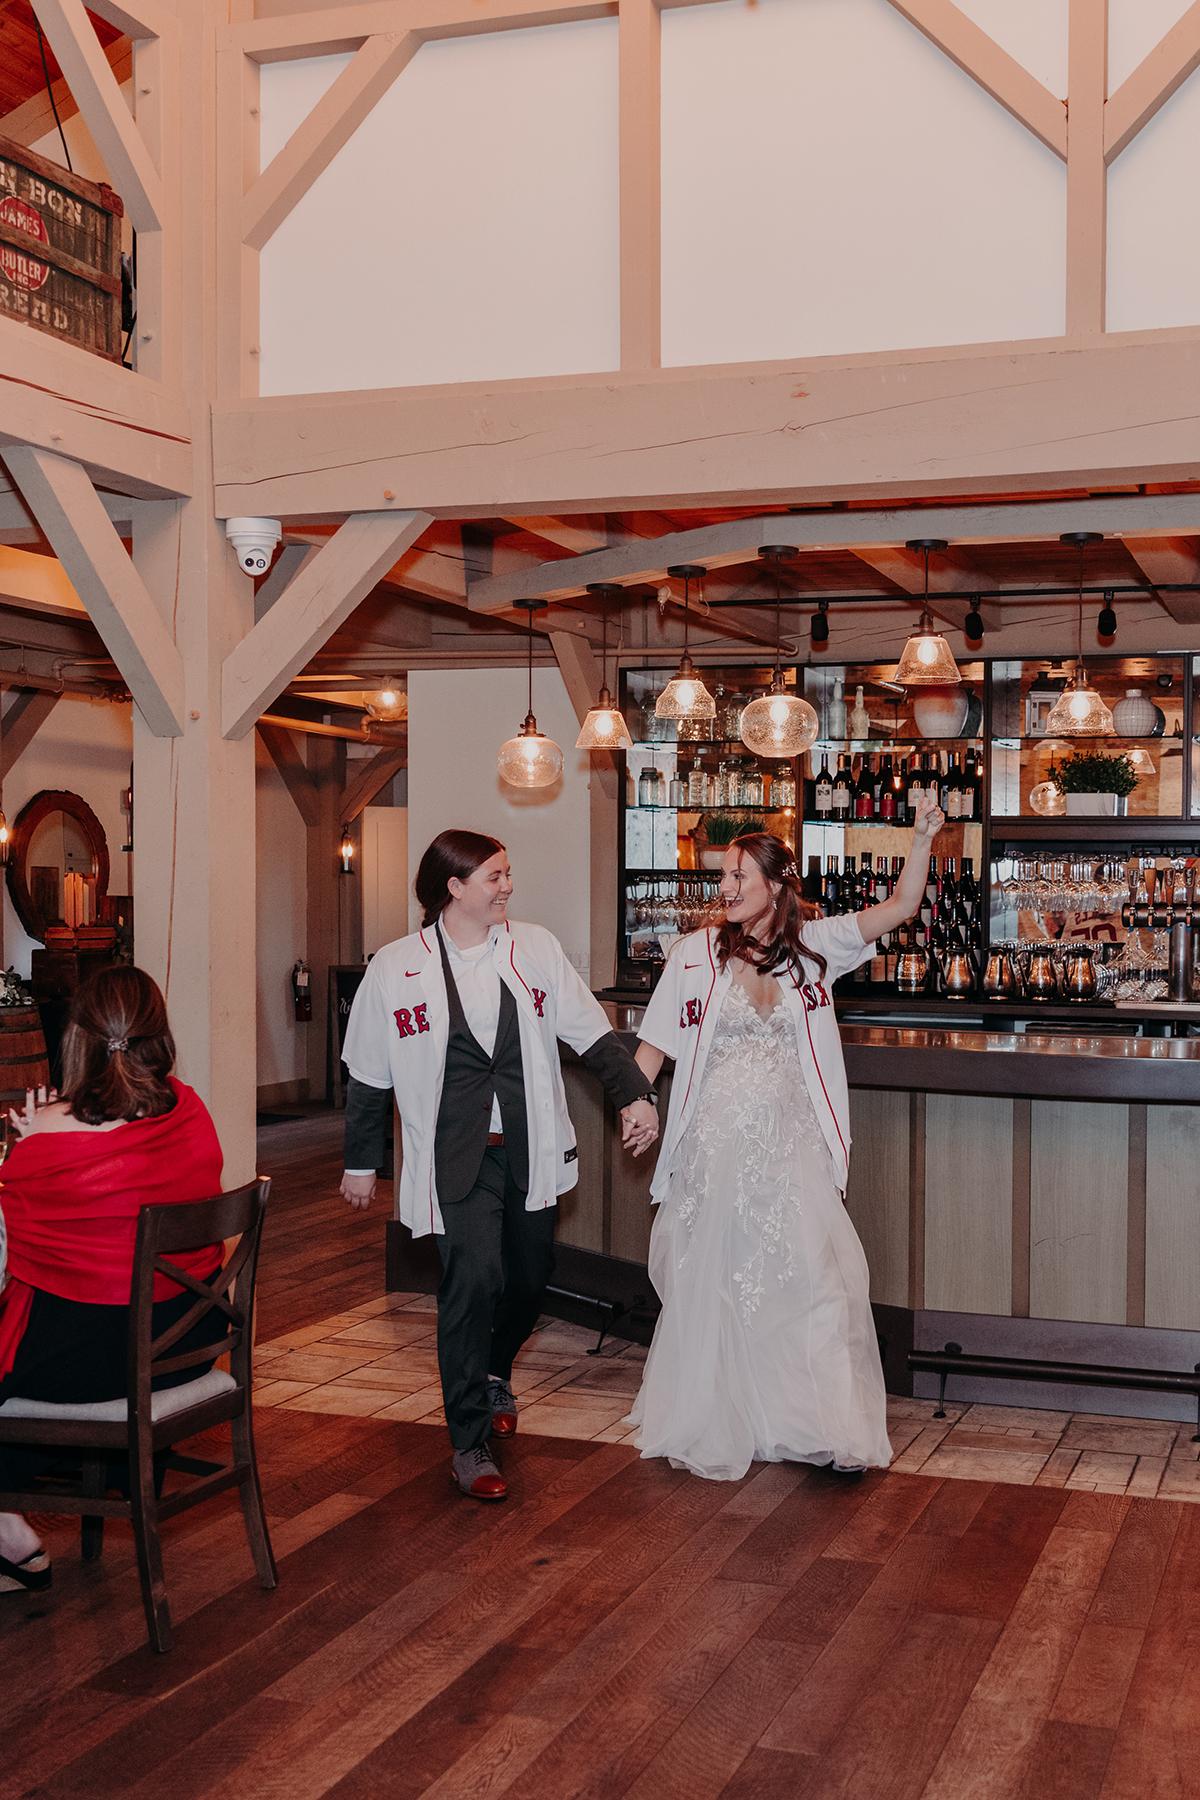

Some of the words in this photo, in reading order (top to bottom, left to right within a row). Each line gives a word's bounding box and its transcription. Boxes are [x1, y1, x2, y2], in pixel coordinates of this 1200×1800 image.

[1, 205, 40, 236] JAMES
[1, 248, 41, 282] BUTLER
[394, 1002, 430, 1038] RE
